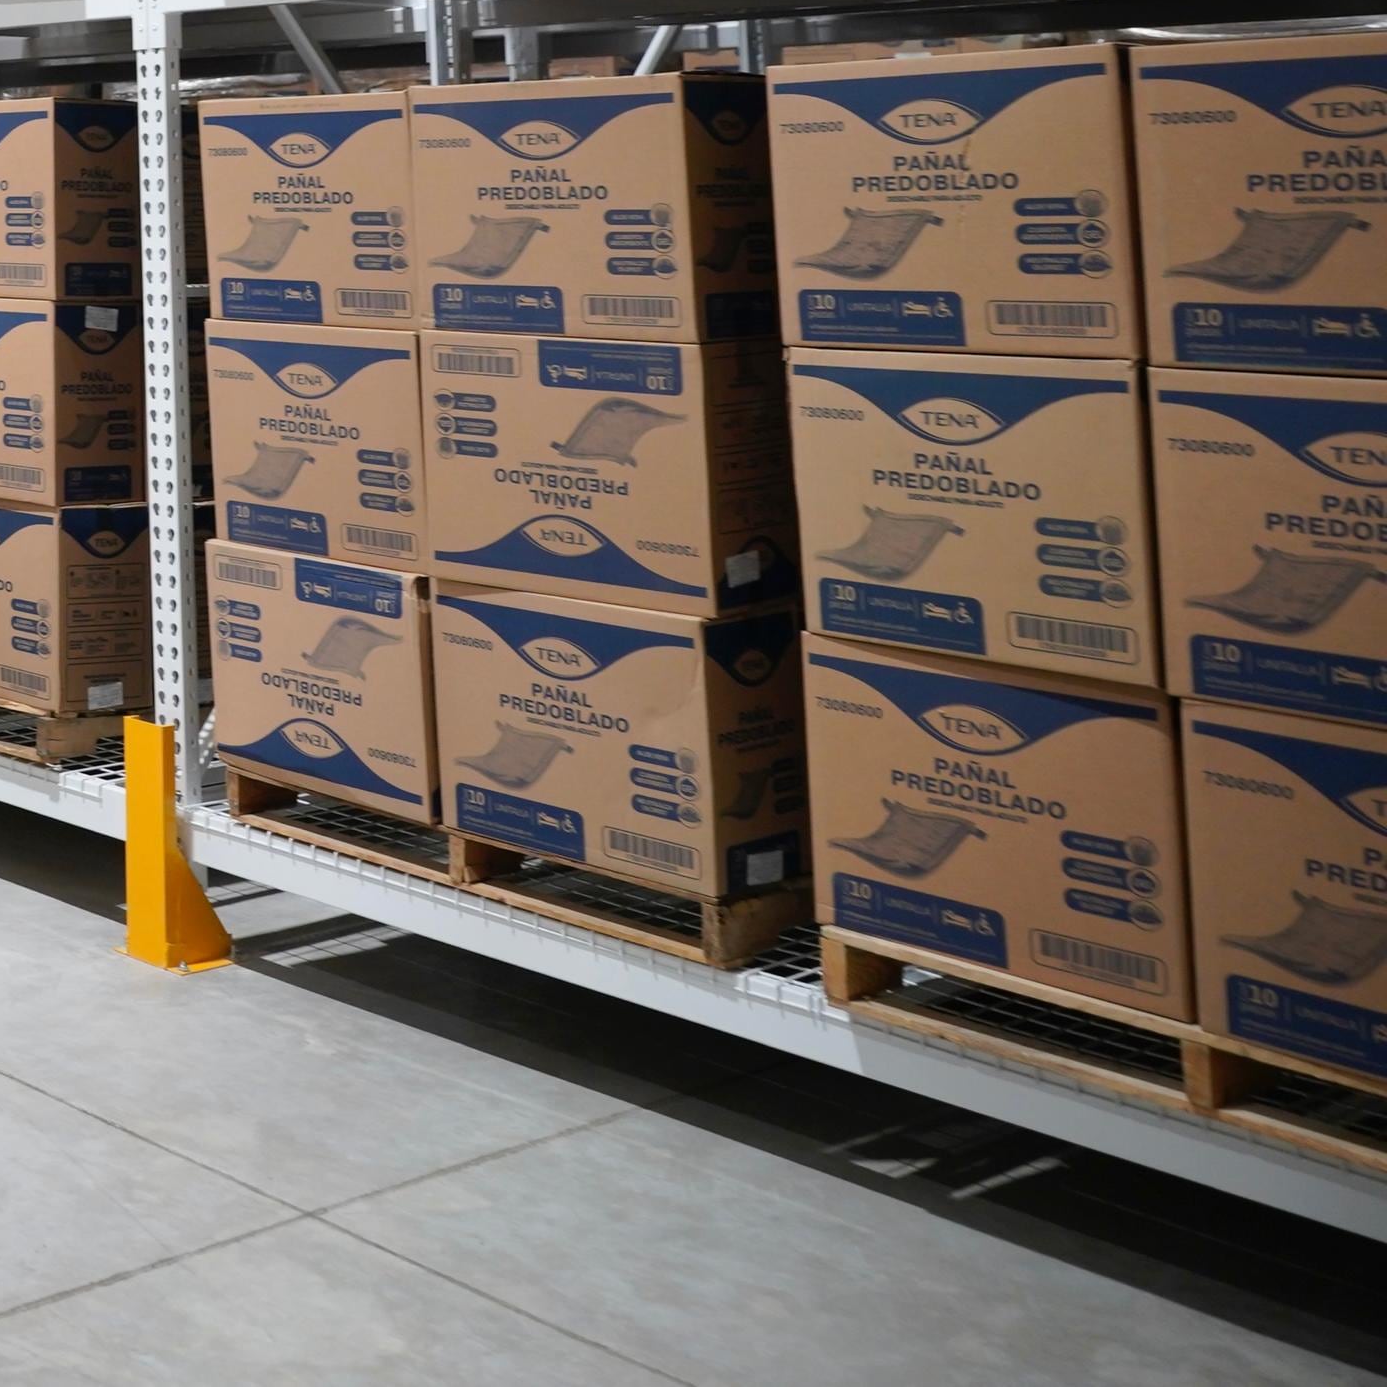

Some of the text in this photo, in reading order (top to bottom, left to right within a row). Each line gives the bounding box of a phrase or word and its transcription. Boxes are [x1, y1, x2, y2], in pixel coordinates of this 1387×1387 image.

[901, 112, 955, 127] TENA
[516, 133, 560, 144] TENA
[282, 144, 315, 154] TENA
[1303, 145, 1387, 168] PAÑA
[893, 151, 969, 171] PAÑAL
[278, 173, 323, 188] PAÑAL
[509, 166, 571, 182] PAÑAL
[853, 174, 1018, 192] PREDOBLADO
[1247, 171, 1387, 192] PREDOBL
[253, 193, 352, 203] PREDOBLADO
[475, 187, 610, 200] PREDOBLADO
[230, 282, 243, 293] 10
[445, 288, 462, 301] 10
[814, 295, 834, 309] 10
[1195, 308, 1223, 327] 10
[289, 373, 322, 385] TENA
[646, 375, 665, 388] 10
[285, 404, 330, 421] PAÑAL
[922, 411, 977, 428] TENA
[259, 418, 359, 439] PREDOBLADO
[915, 451, 990, 475] PAÑAL
[1329, 446, 1387, 466] TEN
[492, 468, 627, 494] PREDOBLADO
[875, 470, 1040, 501] PREDOBLADO
[530, 489, 591, 509] PAÑAL
[1322, 494, 1387, 516] PAÑ
[540, 528, 584, 545] TENA
[835, 585, 855, 602] 10
[374, 598, 389, 611] 10
[537, 647, 580, 666] TENA
[1211, 642, 1241, 662] 10
[260, 672, 361, 705] PREDOBLADO
[530, 683, 590, 707] PAÑAL
[287, 693, 333, 715] PAÑAL
[498, 695, 630, 732] PREDOBLADO
[943, 716, 1000, 738] TENA
[295, 730, 328, 748] TENA
[934, 759, 1014, 788] PAÑAL
[468, 790, 484, 806] 10
[892, 771, 1065, 818] PREDOBLADO
[850, 881, 871, 900] 10
[1249, 985, 1278, 1007] 10
